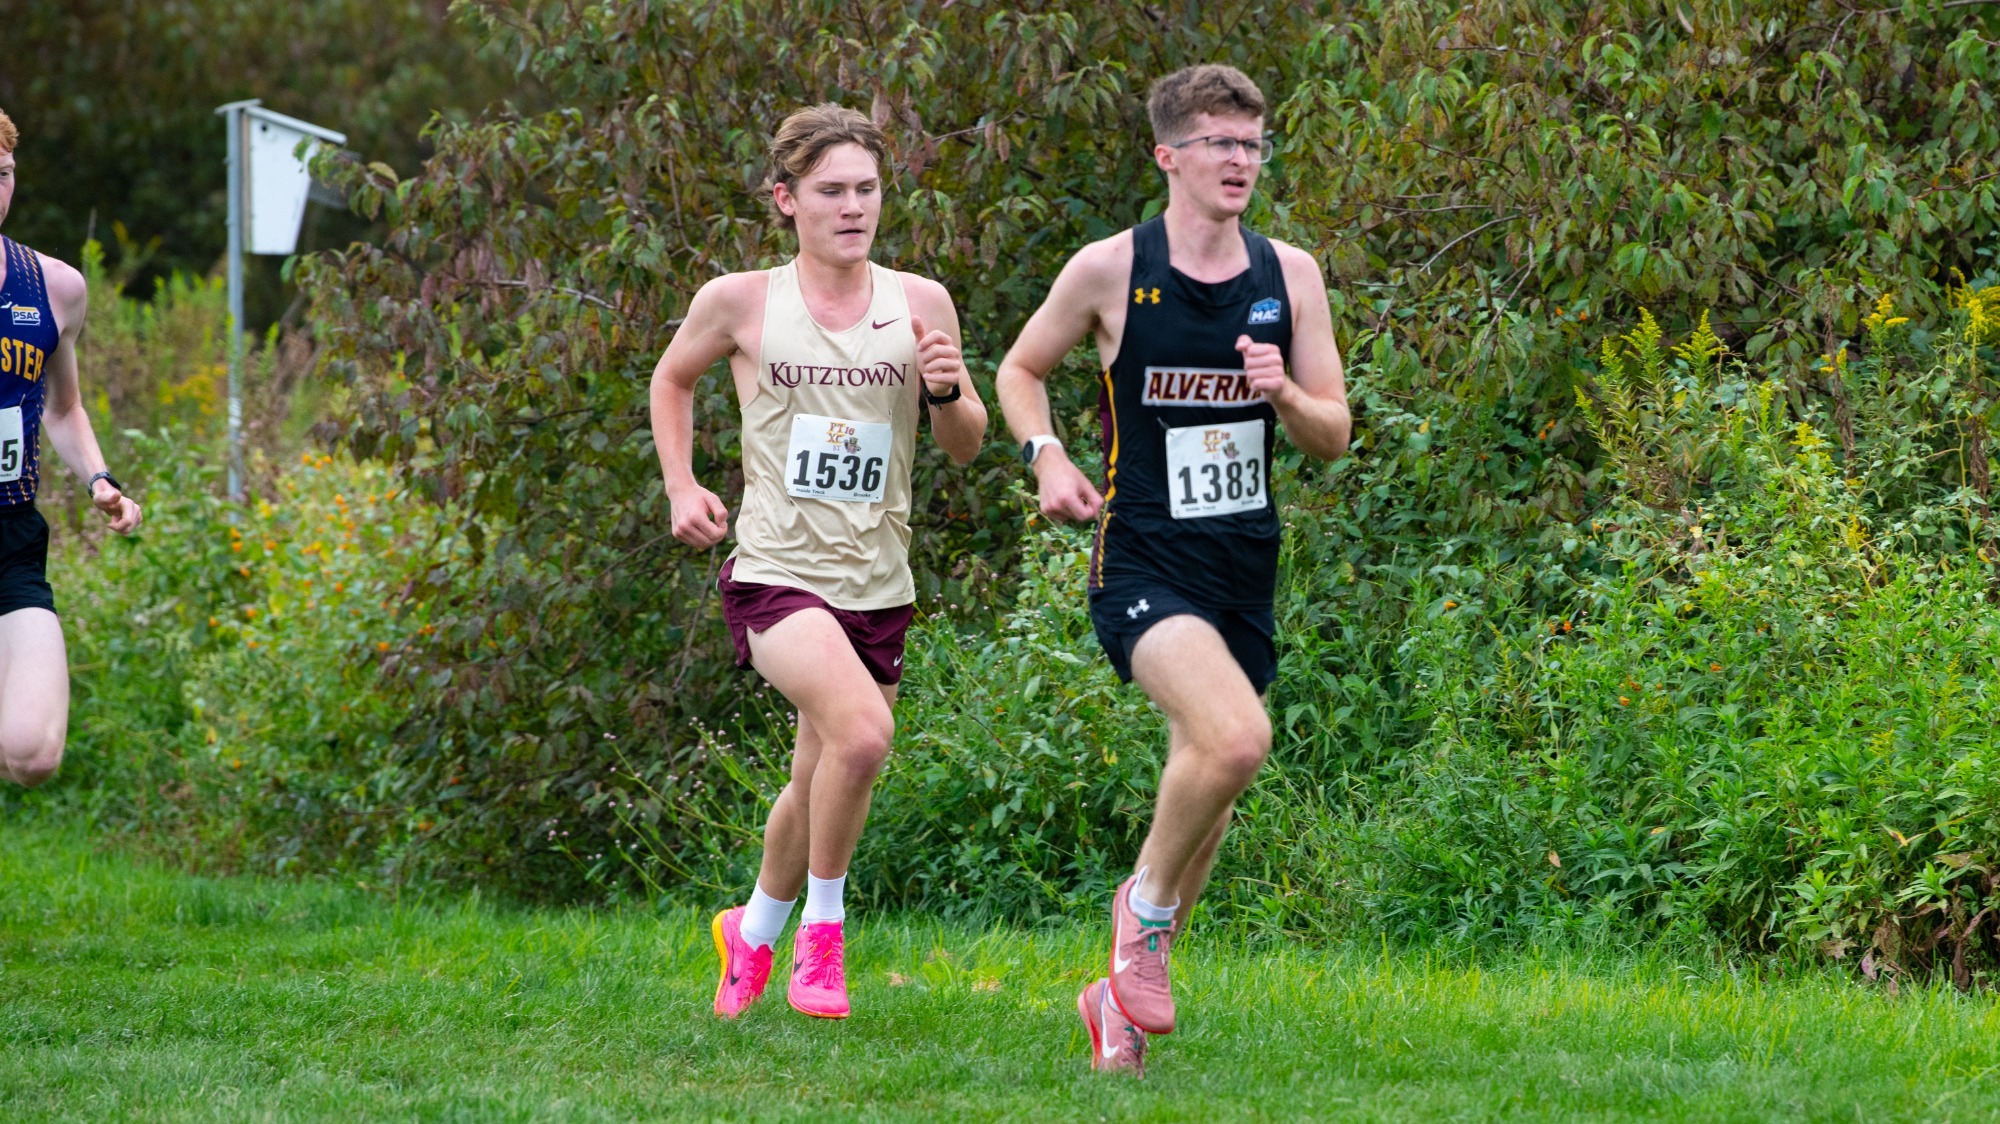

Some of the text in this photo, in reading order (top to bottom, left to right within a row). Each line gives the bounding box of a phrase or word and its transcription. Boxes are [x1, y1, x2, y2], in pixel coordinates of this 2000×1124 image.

[13, 310, 39, 320] PSAC
[1251, 309, 1278, 321] MAC
[0, 336, 44, 383] STER
[769, 361, 908, 388] KUTZTOWN
[1, 438, 18, 472] 5
[793, 449, 883, 492] 1536
[1178, 458, 1259, 505] 1383
